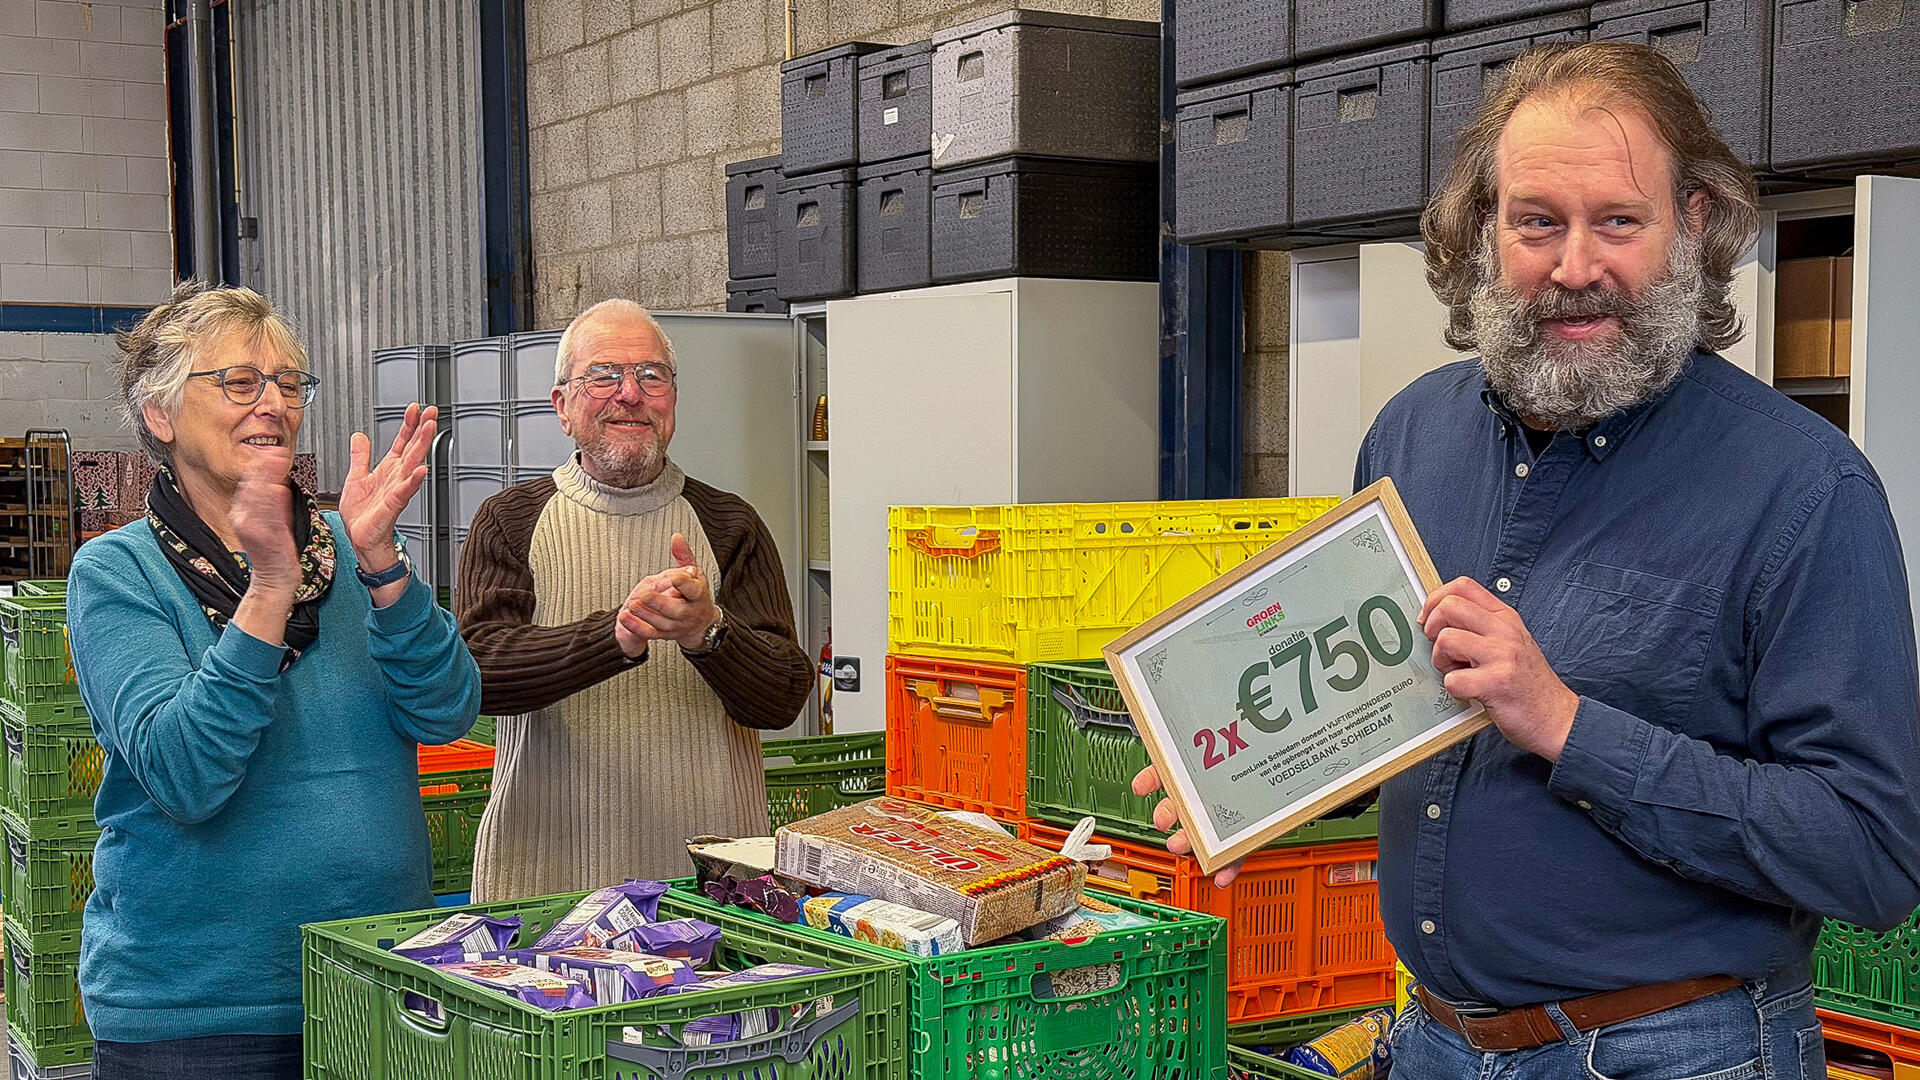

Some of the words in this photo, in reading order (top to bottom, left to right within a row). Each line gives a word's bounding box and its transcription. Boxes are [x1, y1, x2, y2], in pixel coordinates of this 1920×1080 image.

[1246, 602, 1282, 627] GROEN
[1256, 611, 1286, 635] LINKS
[1268, 630, 1305, 655] donatie
[1193, 720, 1249, 771] 2x
[1236, 595, 1413, 734] €750
[1231, 759, 1268, 782] GroenLinks
[1267, 741, 1300, 763] Schiedam
[1300, 726, 1328, 745] doneert
[1327, 690, 1391, 730] VIJFTIENHONDERD
[1392, 678, 1414, 694] EURO
[1259, 767, 1272, 778] van
[1272, 762, 1282, 771] de
[1281, 744, 1316, 766] opbrengst
[1315, 737, 1329, 747] van
[1328, 729, 1344, 741] haar
[1344, 709, 1379, 731] winddelen
[1379, 702, 1393, 713] aan
[1267, 743, 1341, 787] VOEDSELBANK
[1340, 714, 1394, 749] SCHIEDAM
